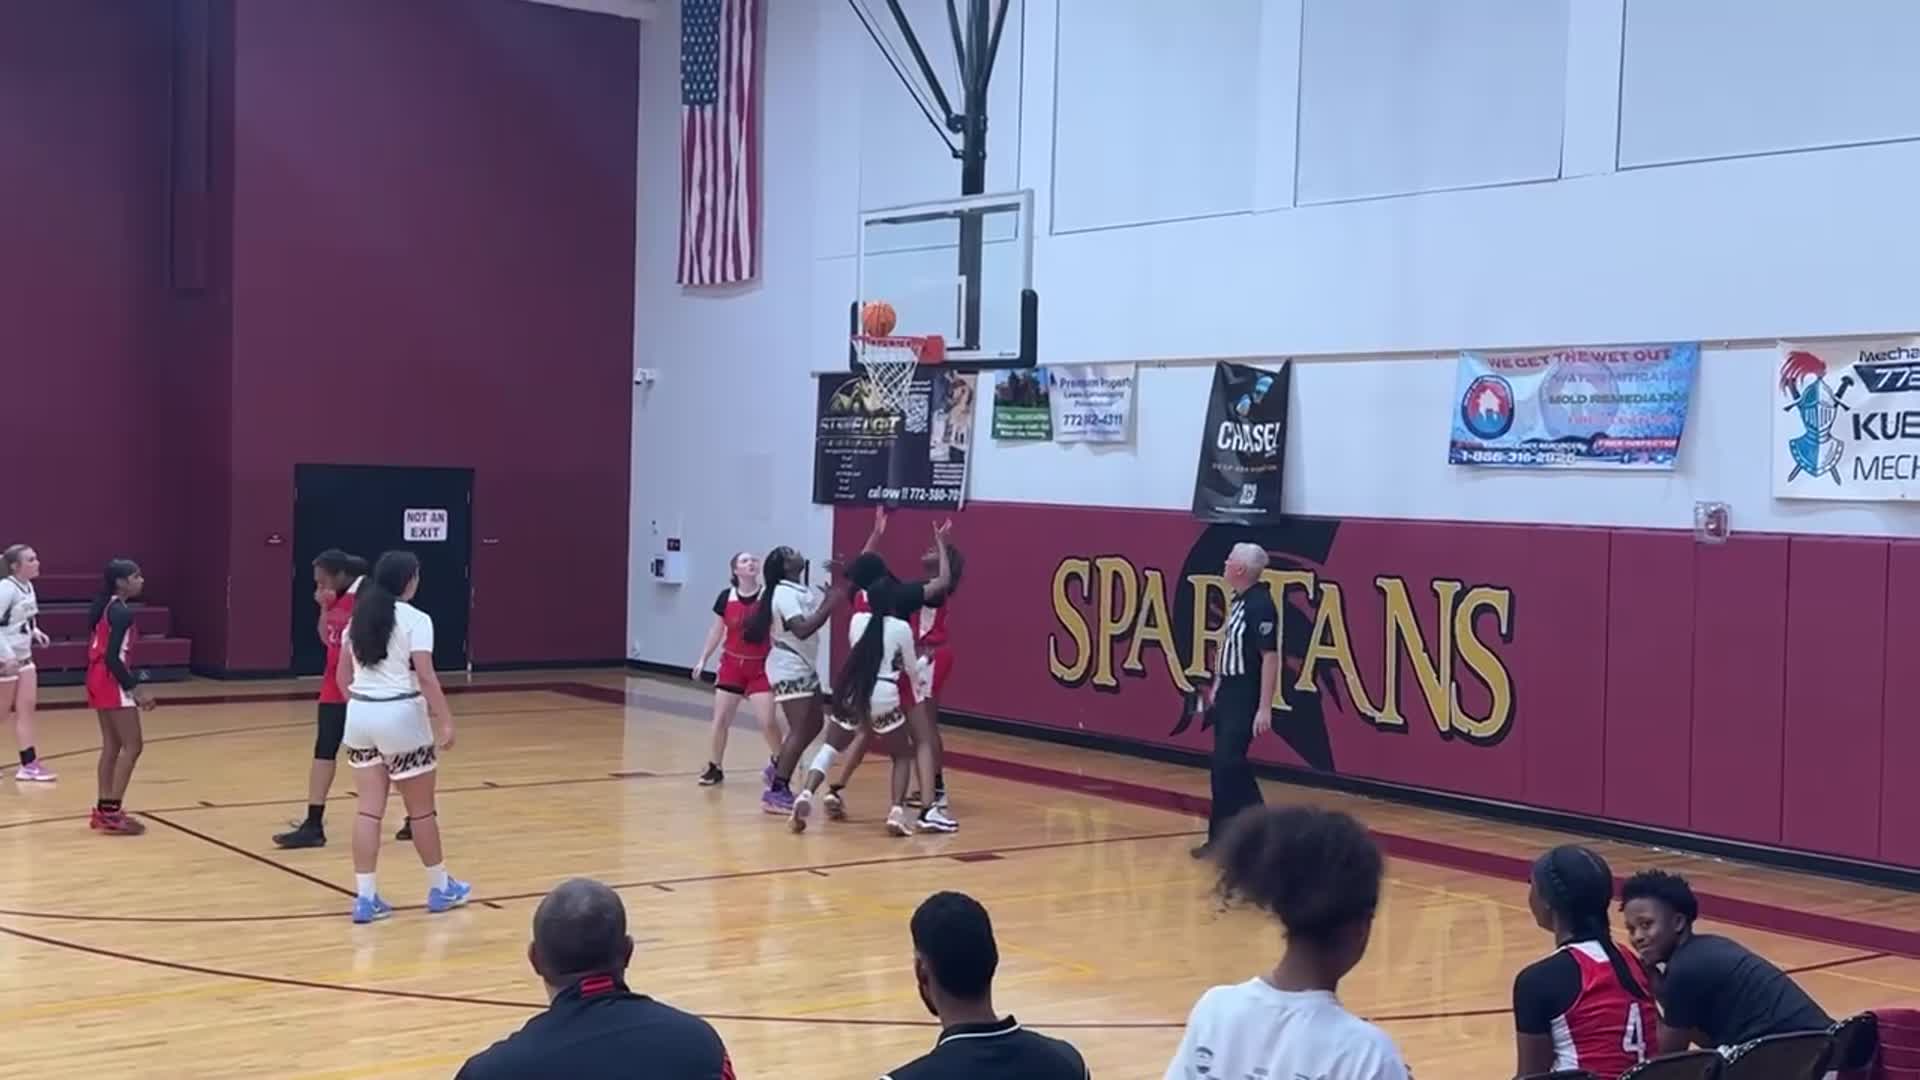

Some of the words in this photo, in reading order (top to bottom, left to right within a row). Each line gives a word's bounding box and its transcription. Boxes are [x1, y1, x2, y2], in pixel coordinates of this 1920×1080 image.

[1515, 355, 1550, 369] GET
[1556, 350, 1589, 363] THE
[1591, 350, 1630, 363] WET
[1632, 348, 1672, 362] OUT
[1549, 394, 1588, 405] MOLD
[407, 511, 427, 523] NOT
[430, 511, 445, 523] AN
[411, 527, 440, 538] EXIT
[1048, 555, 1515, 741] SPARTANS
[1623, 1002, 1646, 1064] 4
